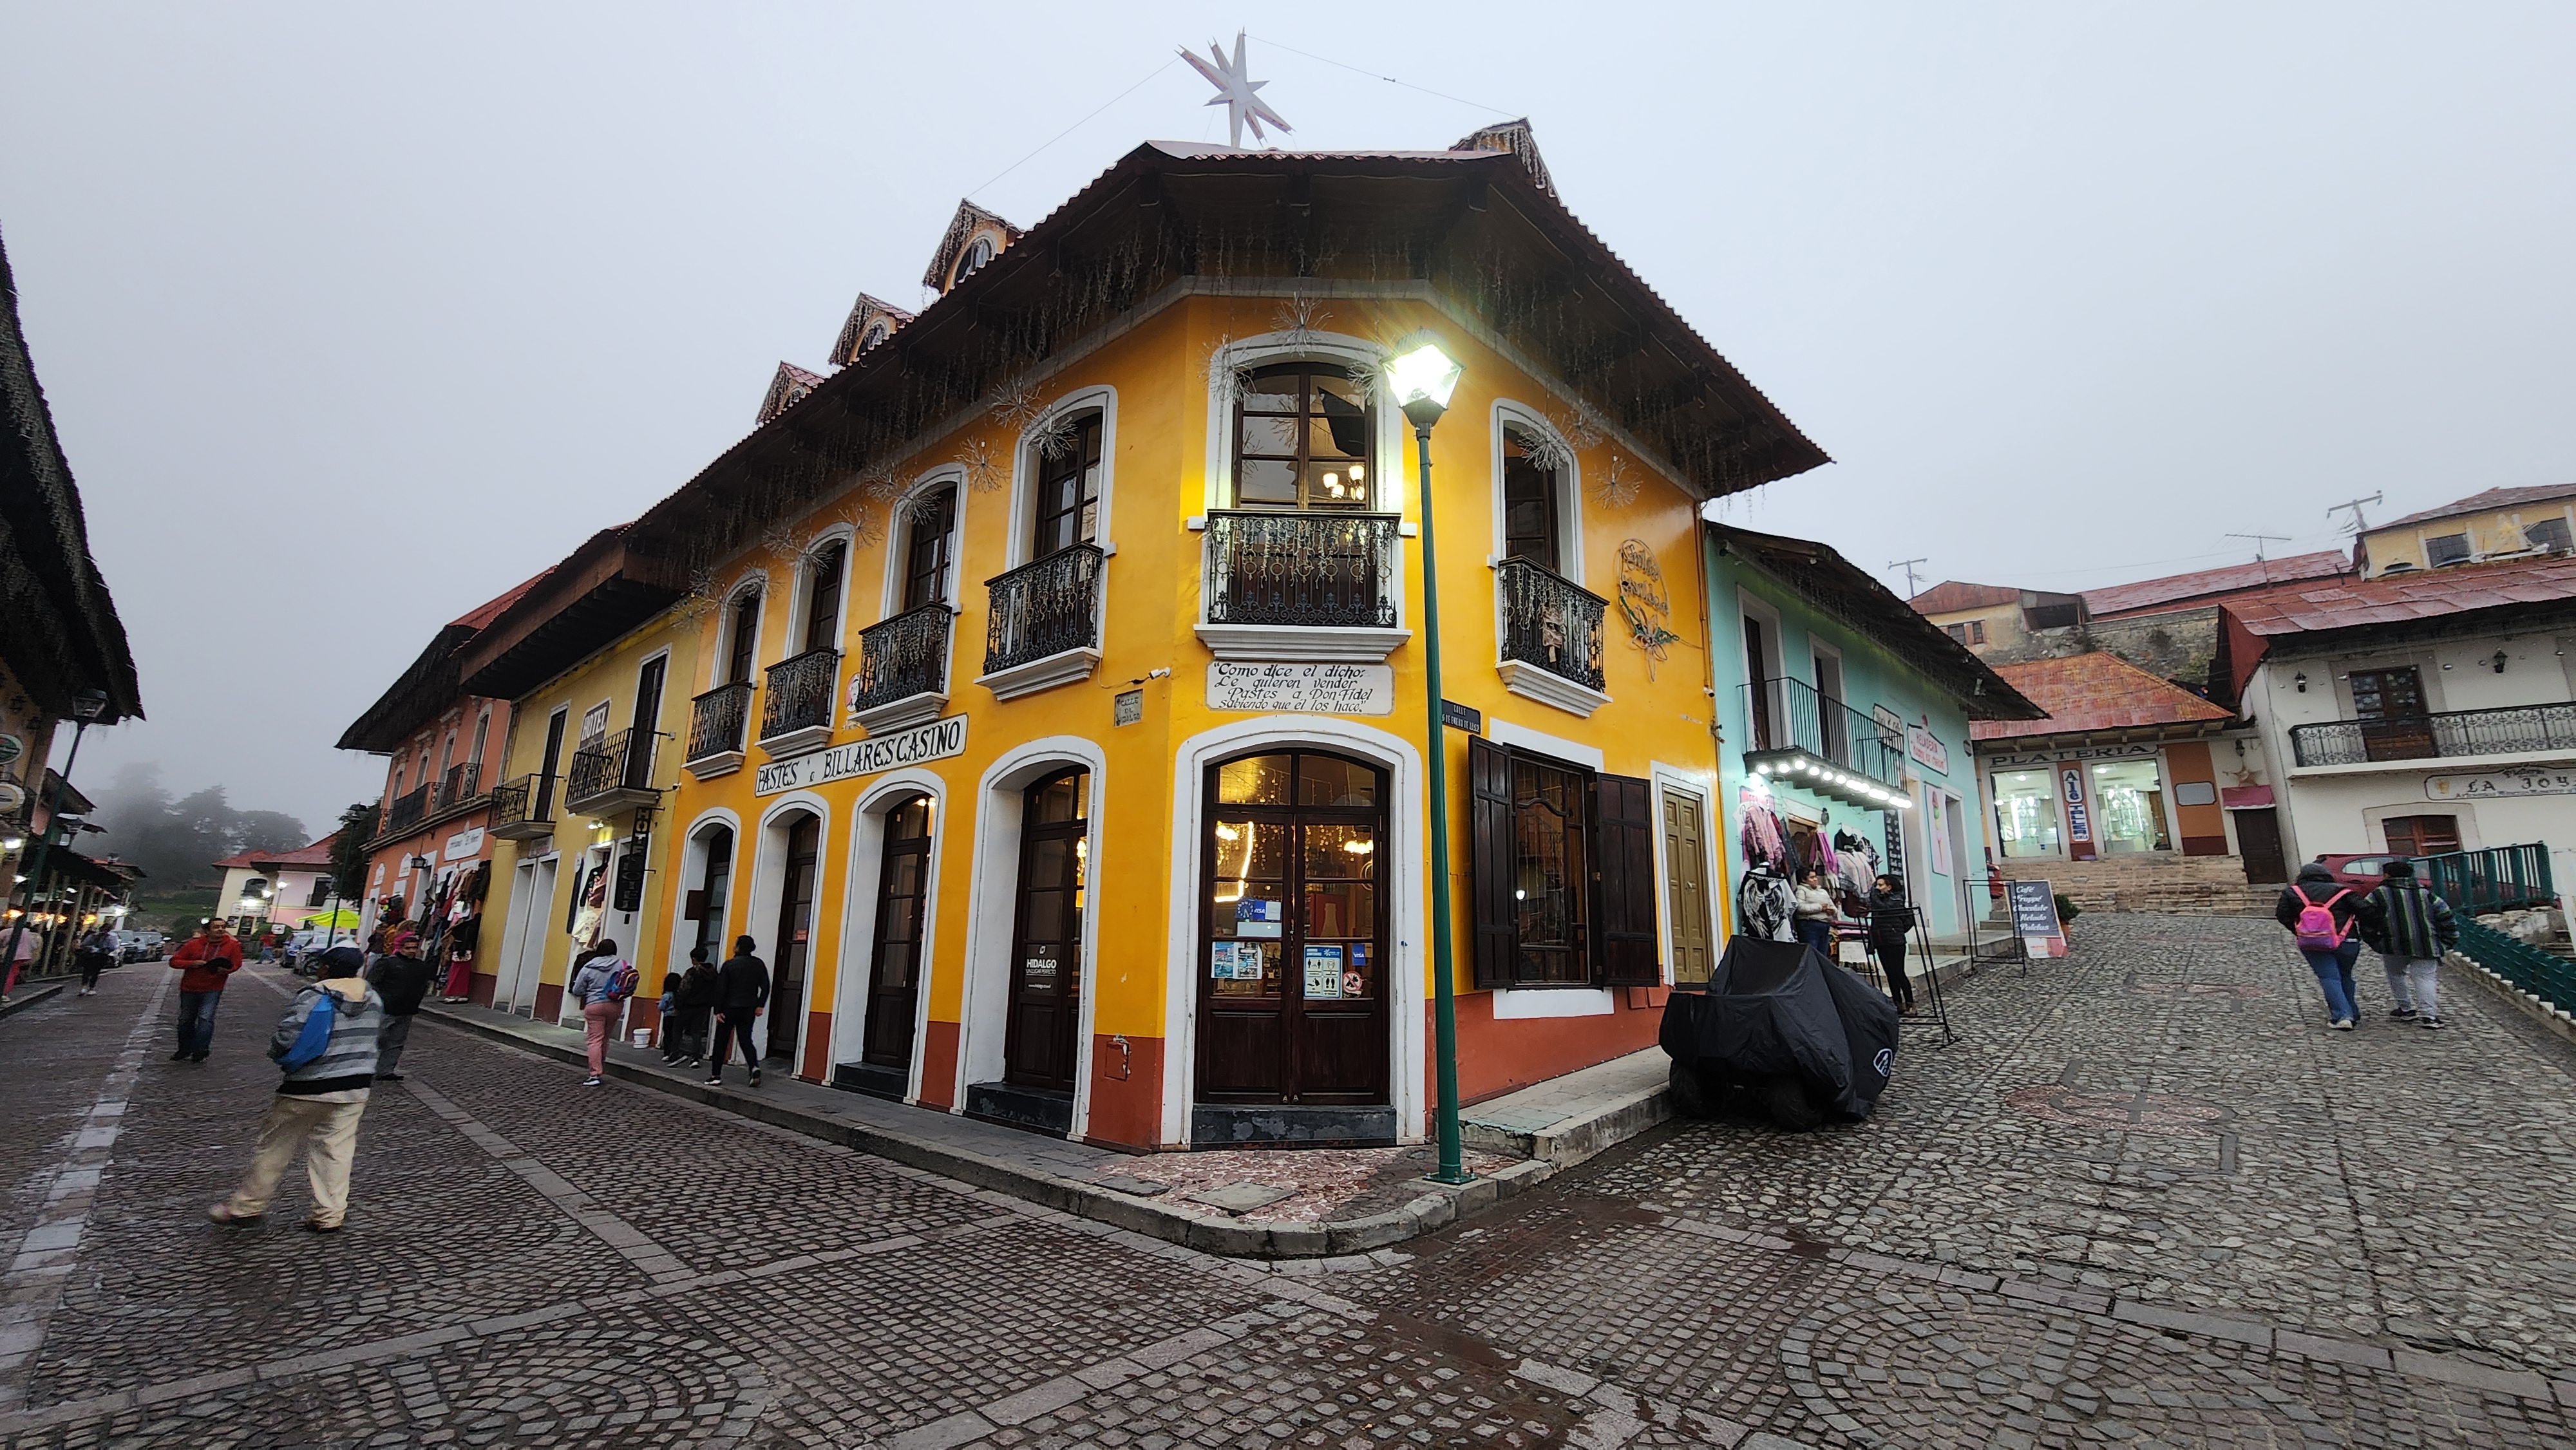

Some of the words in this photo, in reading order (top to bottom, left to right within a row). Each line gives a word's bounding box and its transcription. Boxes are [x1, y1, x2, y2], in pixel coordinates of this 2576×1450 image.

[1264, 664, 1293, 679] dice
[1303, 664, 1316, 678] el
[1214, 676, 1239, 688] Le
[1253, 677, 1301, 690] quieren
[1313, 678, 1358, 690] vender
[1228, 687, 1278, 701] Pastes
[1292, 690, 1302, 700] a
[1309, 688, 1336, 701] Don
[1339, 689, 1373, 701] Fidel
[1218, 699, 1269, 710] sabiendo
[1273, 701, 1291, 711] que
[1311, 699, 1329, 711] los
[1453, 704, 1467, 716] CALLE
[581, 706, 607, 742] HOTEL
[756, 760, 800, 793] PASTES
[822, 738, 896, 780] BILLARES
[896, 720, 961, 762] CASINO
[2065, 771, 2080, 800] Ale
[2467, 778, 2496, 793] LA
[2069, 805, 2087, 835] TALLER
[2016, 885, 2035, 894] Café
[1027, 959, 1057, 969] HIDALGO
